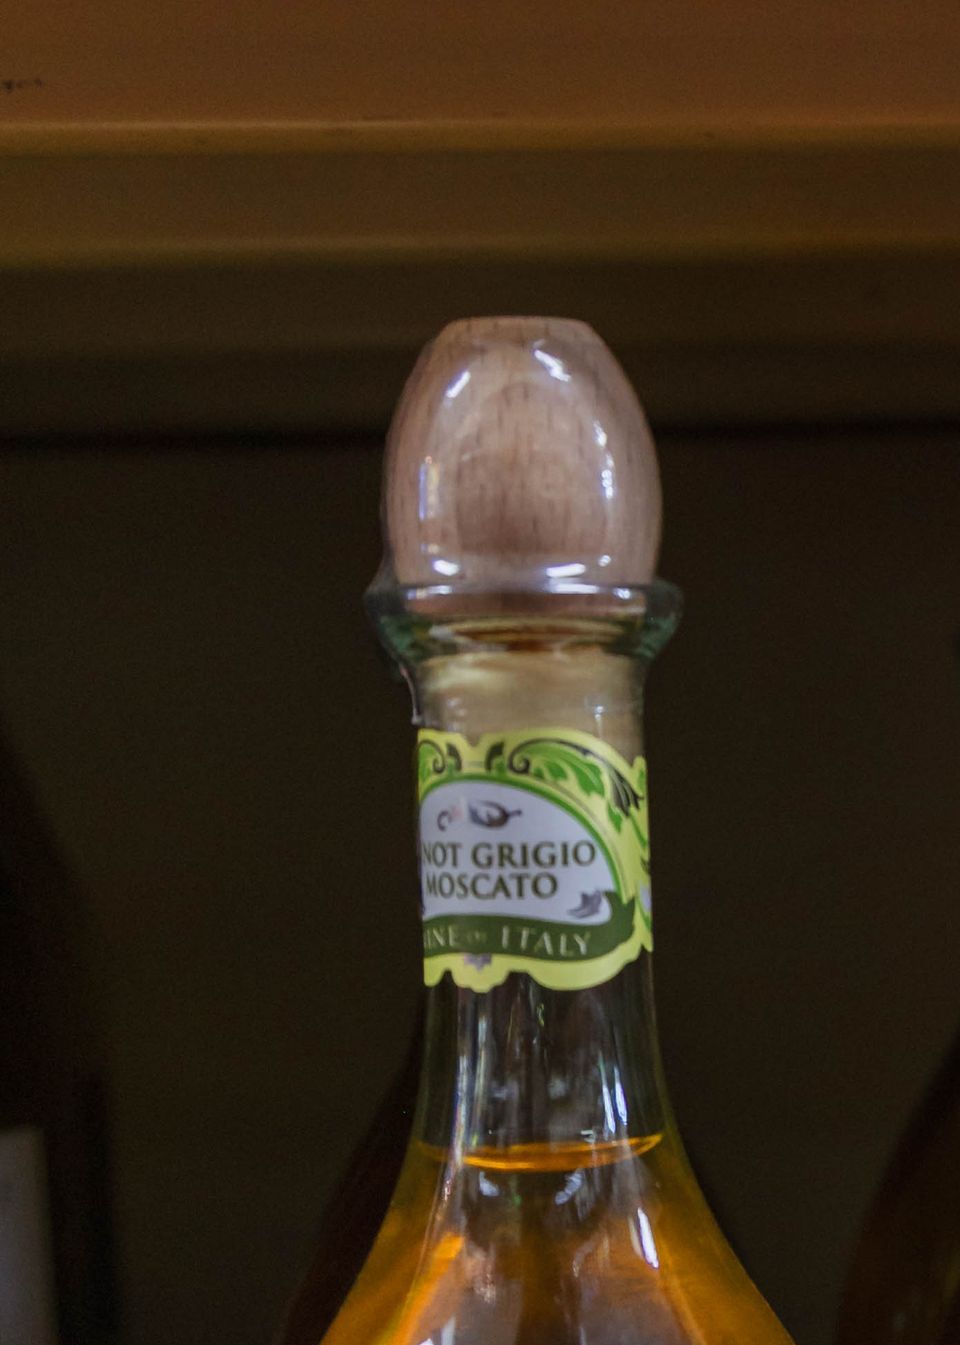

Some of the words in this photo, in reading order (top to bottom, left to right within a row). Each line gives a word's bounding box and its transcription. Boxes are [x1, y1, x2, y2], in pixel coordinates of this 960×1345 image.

[471, 839, 596, 870] GRIGIO
[425, 871, 558, 900] MOSCATO
[501, 926, 593, 956] ITALY
